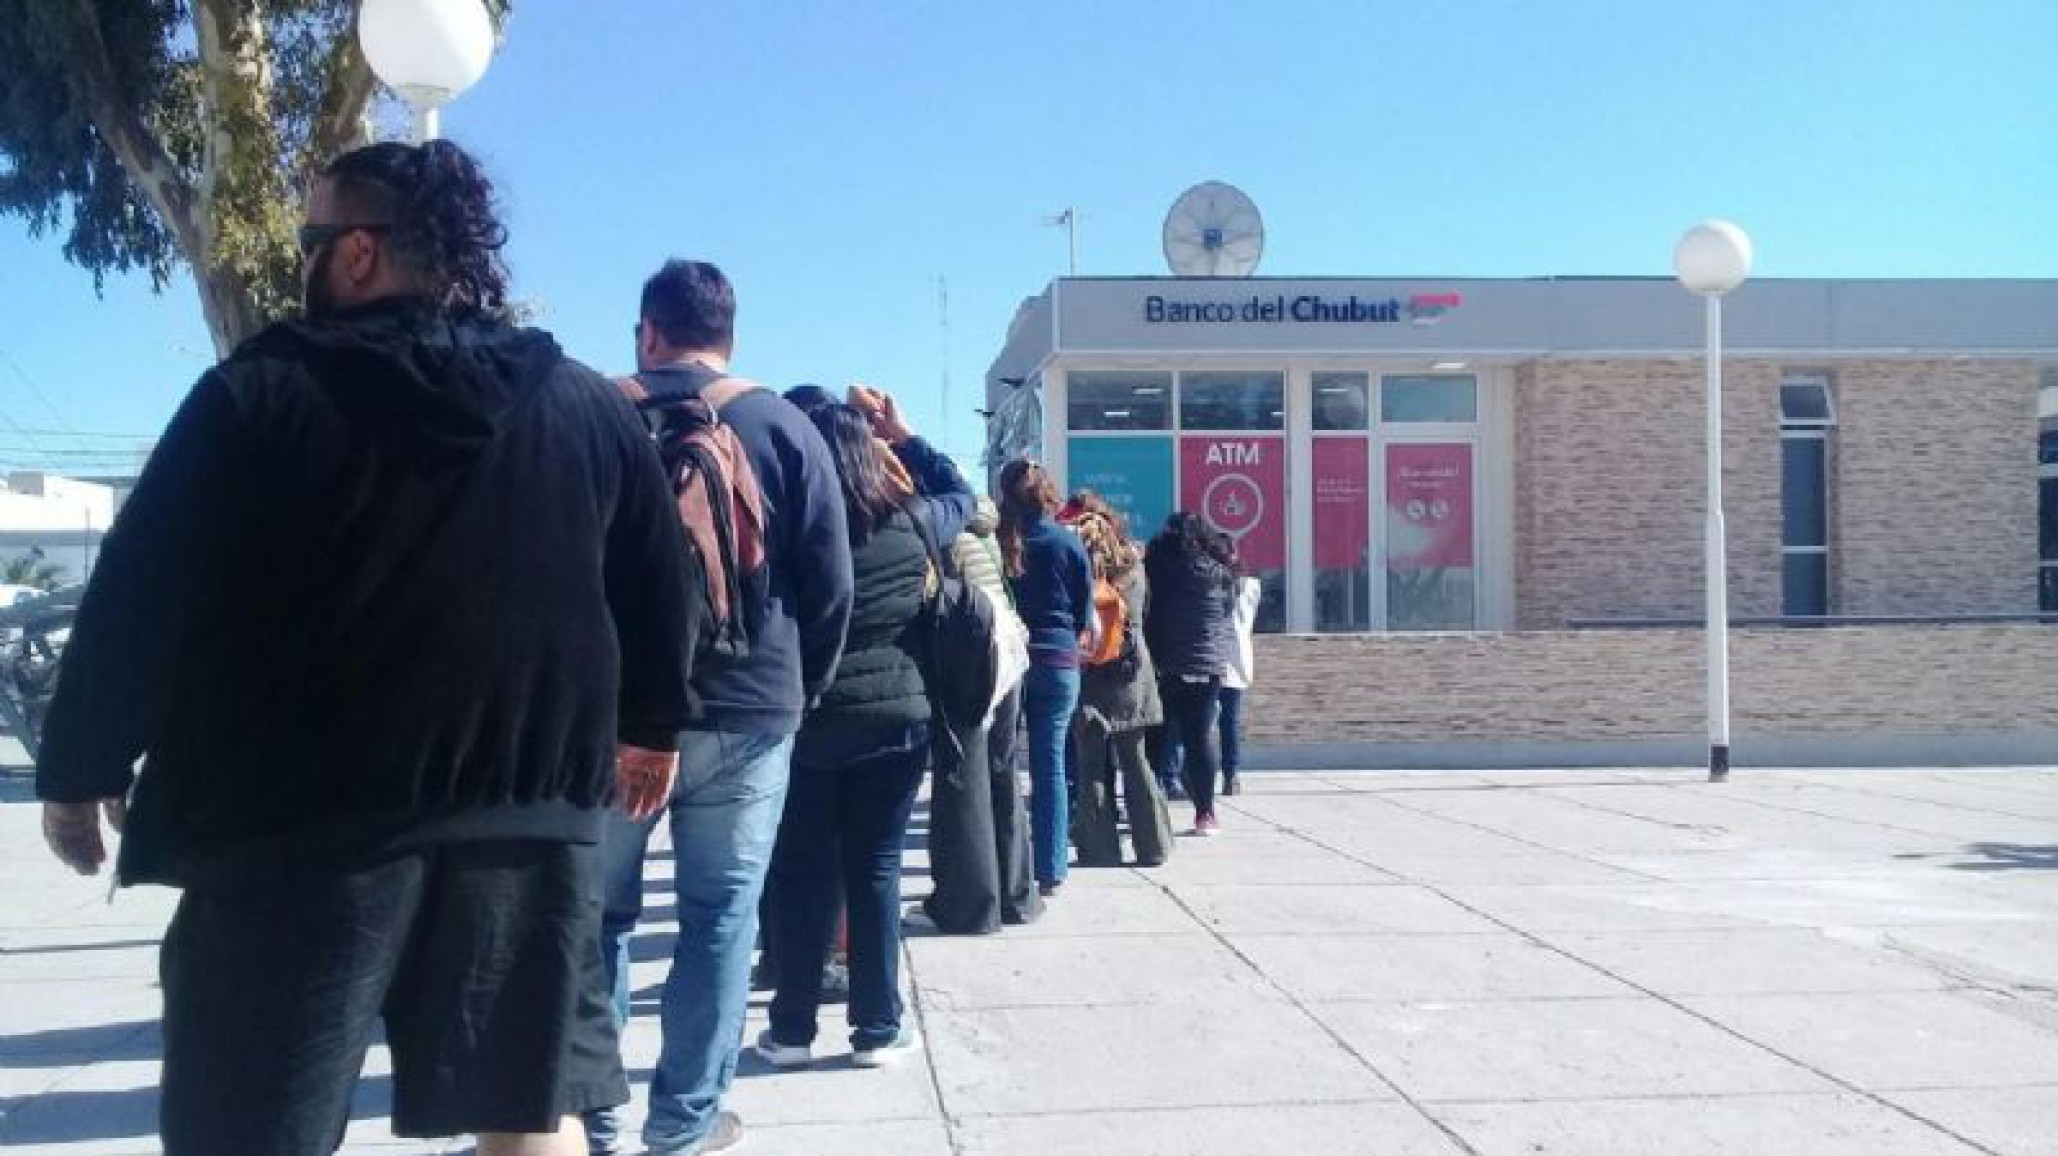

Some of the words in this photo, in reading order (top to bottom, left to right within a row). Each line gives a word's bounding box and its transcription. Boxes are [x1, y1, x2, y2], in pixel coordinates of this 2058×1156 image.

[1146, 296, 1235, 323] Banco
[1241, 296, 1285, 323] del
[1290, 296, 1401, 323] Chubut
[1205, 442, 1260, 465] ATM
